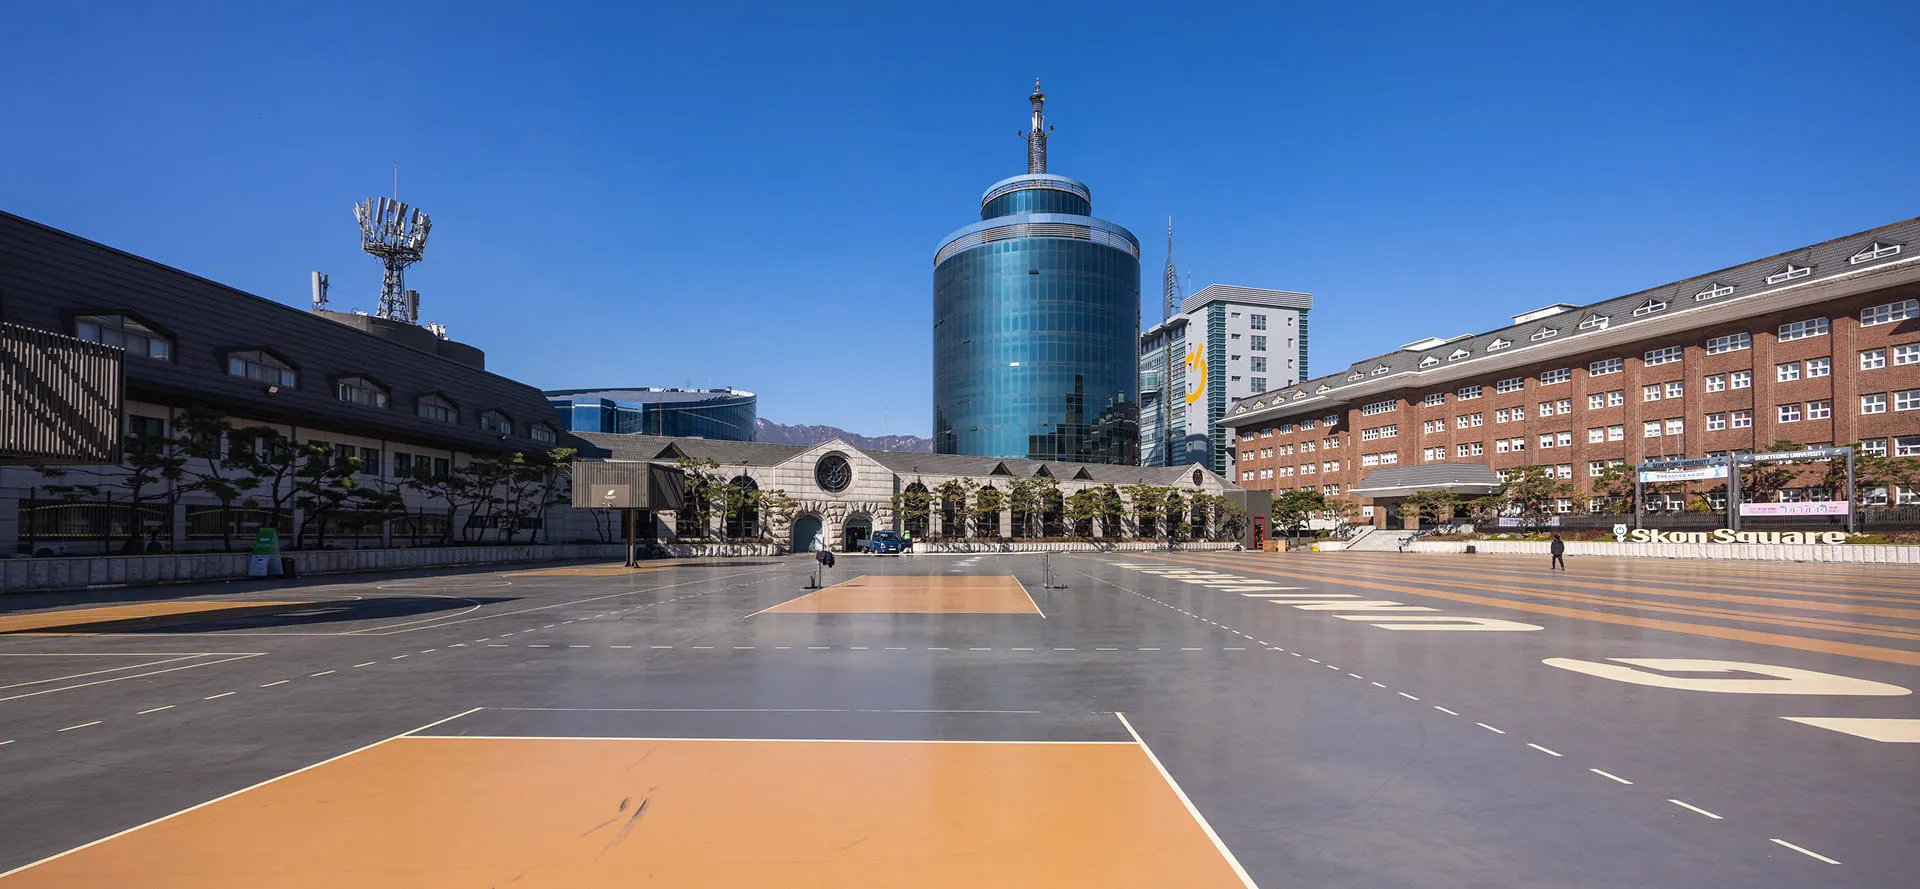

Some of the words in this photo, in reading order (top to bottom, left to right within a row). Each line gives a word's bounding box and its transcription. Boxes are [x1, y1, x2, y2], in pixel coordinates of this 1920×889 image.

[1790, 450, 1826, 458] UNIVERSITY
[1631, 528, 1707, 543] Skon
[1713, 528, 1846, 545] Square
